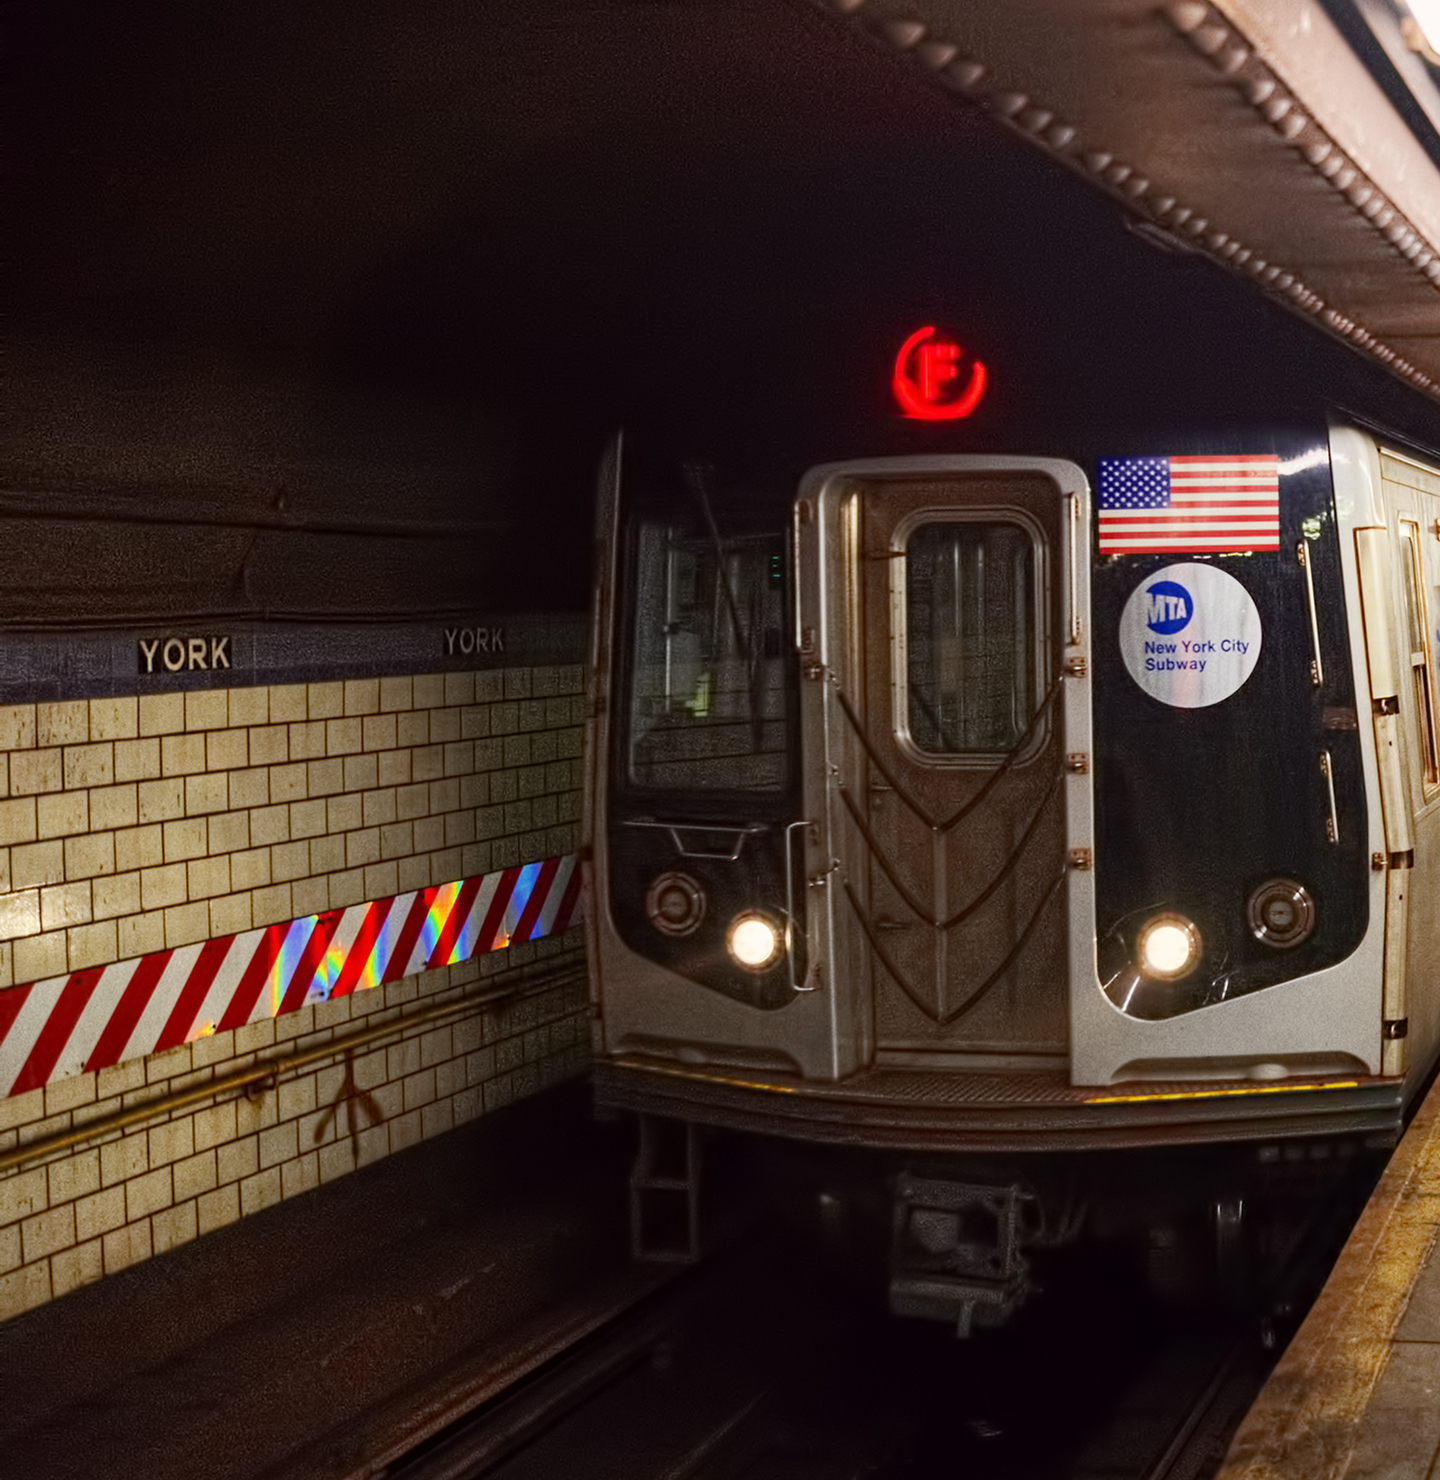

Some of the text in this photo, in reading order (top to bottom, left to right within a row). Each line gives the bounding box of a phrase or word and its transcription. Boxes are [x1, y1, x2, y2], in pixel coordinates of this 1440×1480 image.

[919, 344, 960, 401] F
[1145, 593, 1187, 624] MTA
[139, 637, 231, 673] YORK
[445, 627, 504, 655] YORK
[1145, 639, 1250, 655] New York City
[1145, 658, 1207, 672] Subway
